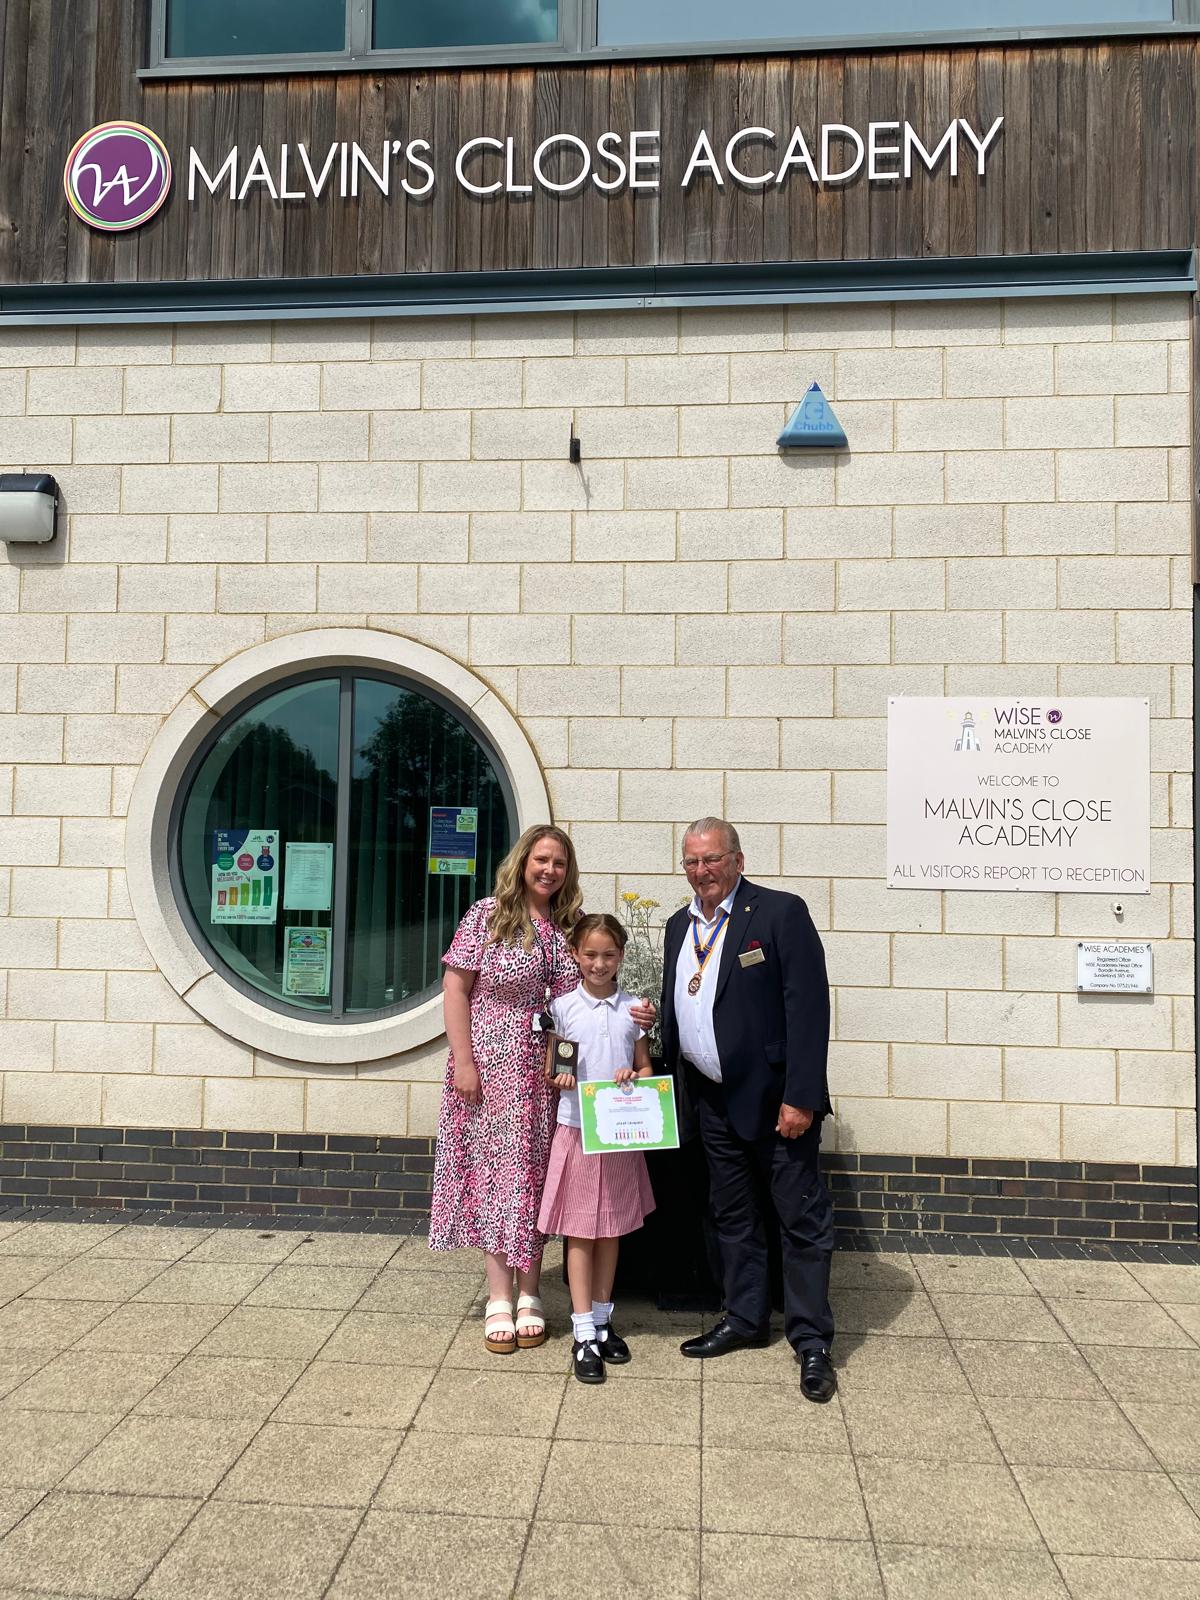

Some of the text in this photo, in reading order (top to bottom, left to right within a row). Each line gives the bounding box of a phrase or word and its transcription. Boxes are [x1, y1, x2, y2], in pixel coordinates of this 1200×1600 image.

[188, 117, 1005, 201] MALVIN'S CLOSE ACADEMY
[795, 421, 834, 431] Chubb
[994, 707, 1041, 725] WISE
[994, 728, 1092, 740] MALVIN'S CLOSE
[994, 743, 1053, 754] ACADEMY
[977, 775, 1060, 787] WELCOME TO
[924, 798, 1112, 822] MALVIN'S CLOSE
[958, 825, 1078, 847] ACADEMY
[893, 864, 1145, 882] ALL VISITORS REPORT TO RECEPTION
[1084, 945, 1144, 954] WISE ACADEMIES
